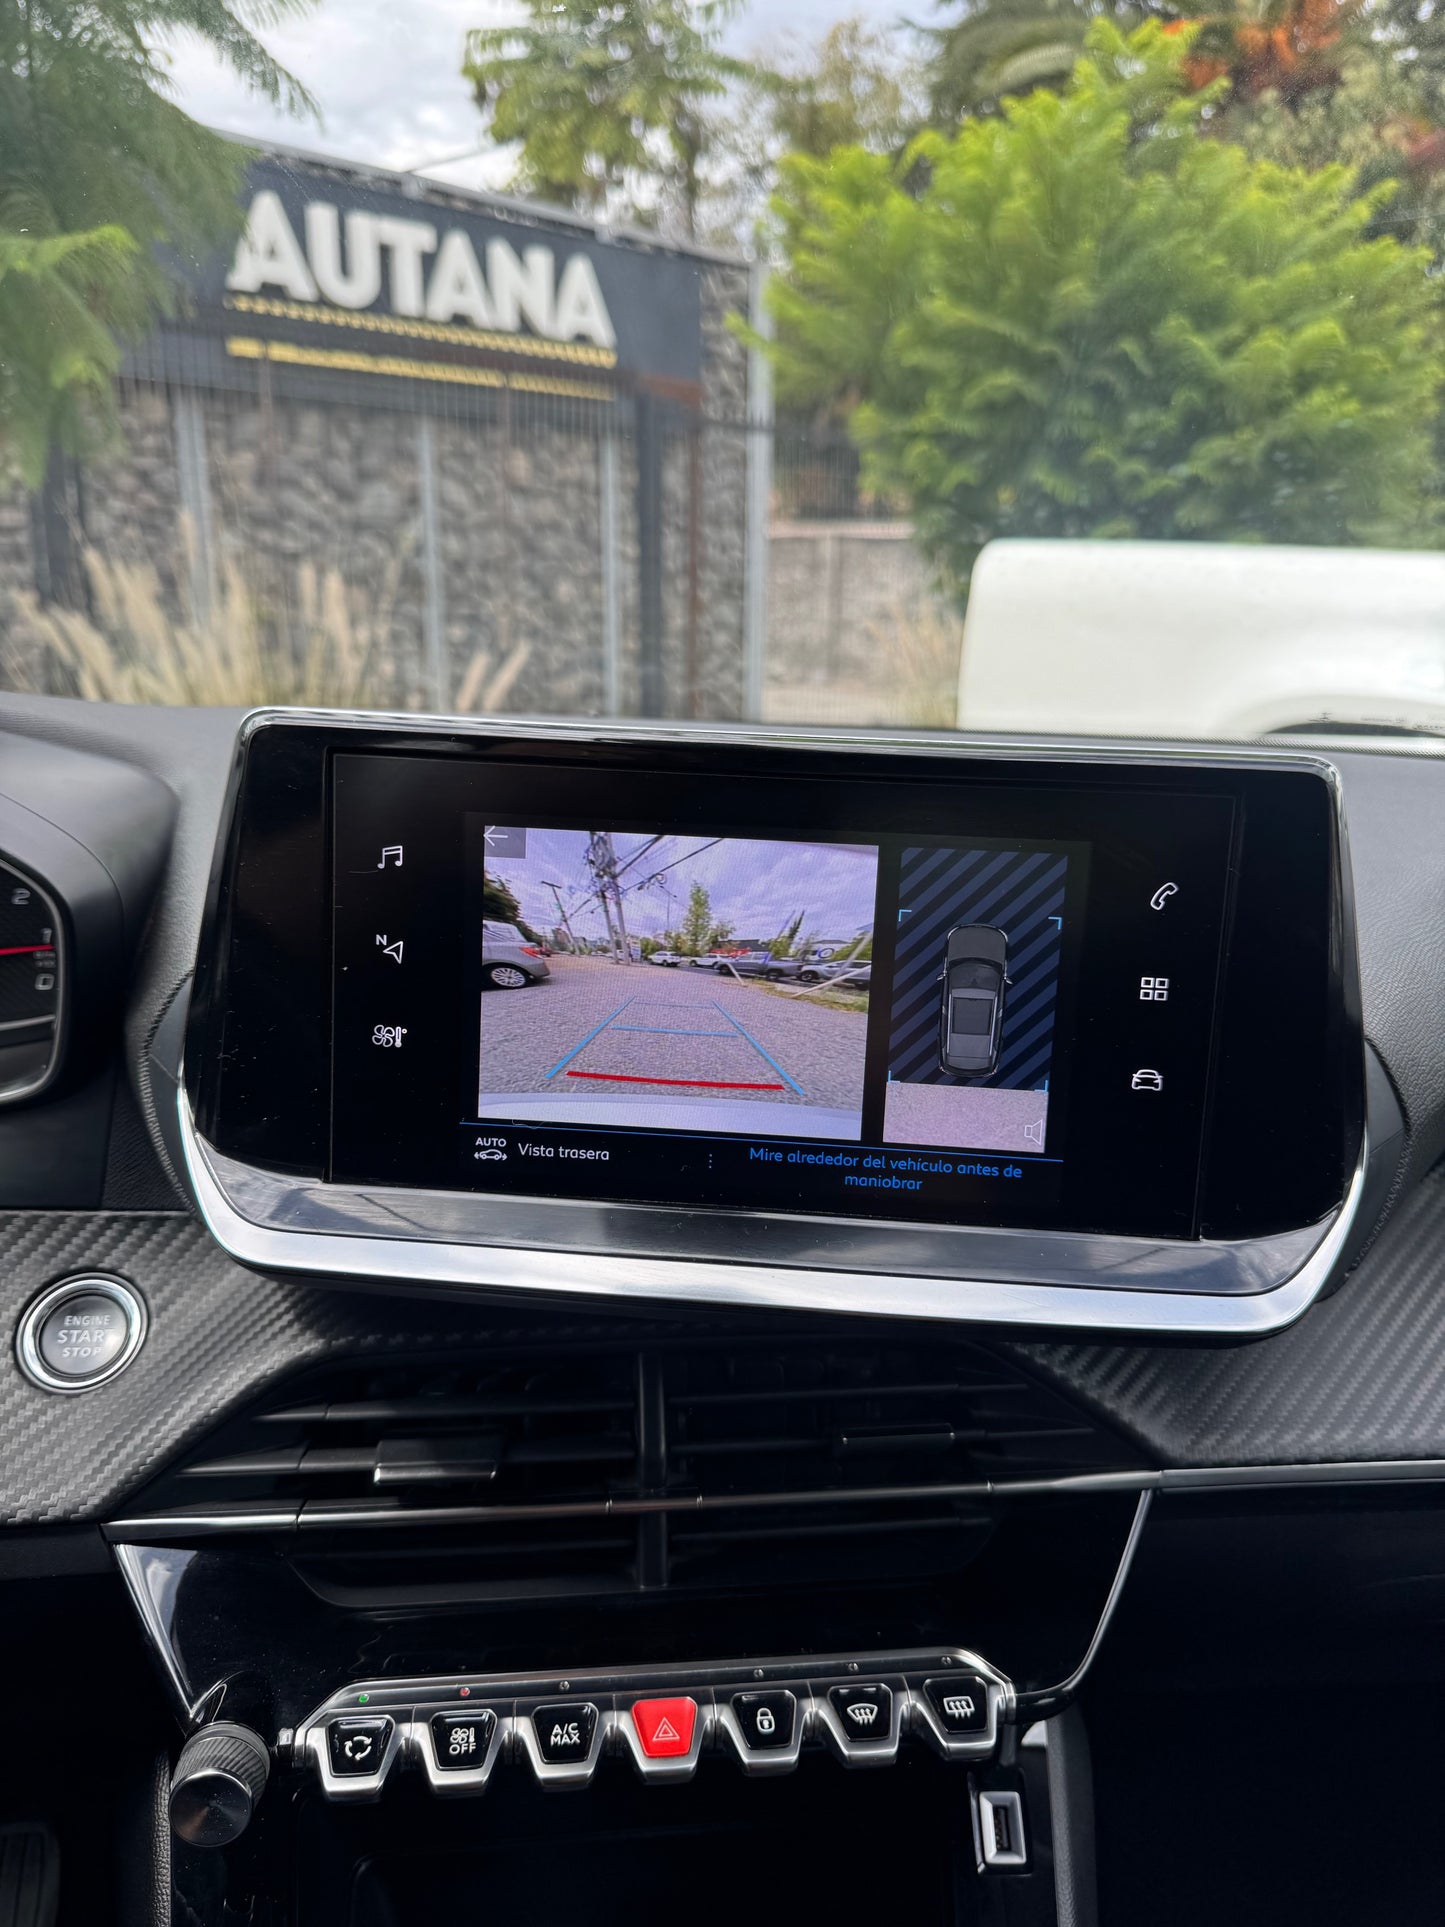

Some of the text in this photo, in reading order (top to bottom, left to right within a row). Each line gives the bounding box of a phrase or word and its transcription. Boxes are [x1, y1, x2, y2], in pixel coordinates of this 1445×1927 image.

[226, 189, 617, 347] AUTANA
[11, 887, 31, 905] 2
[475, 1137, 507, 1147] AUTO
[517, 1143, 610, 1161] Vista trasera
[750, 1147, 1023, 1178] Mire alrededor del vehículo antes de
[844, 1174, 923, 1190] maniobrar
[64, 1315, 111, 1326] ENGINE
[552, 1723, 579, 1735] A/C
[550, 1733, 580, 1745] MAX
[449, 1742, 476, 1755] OFF
